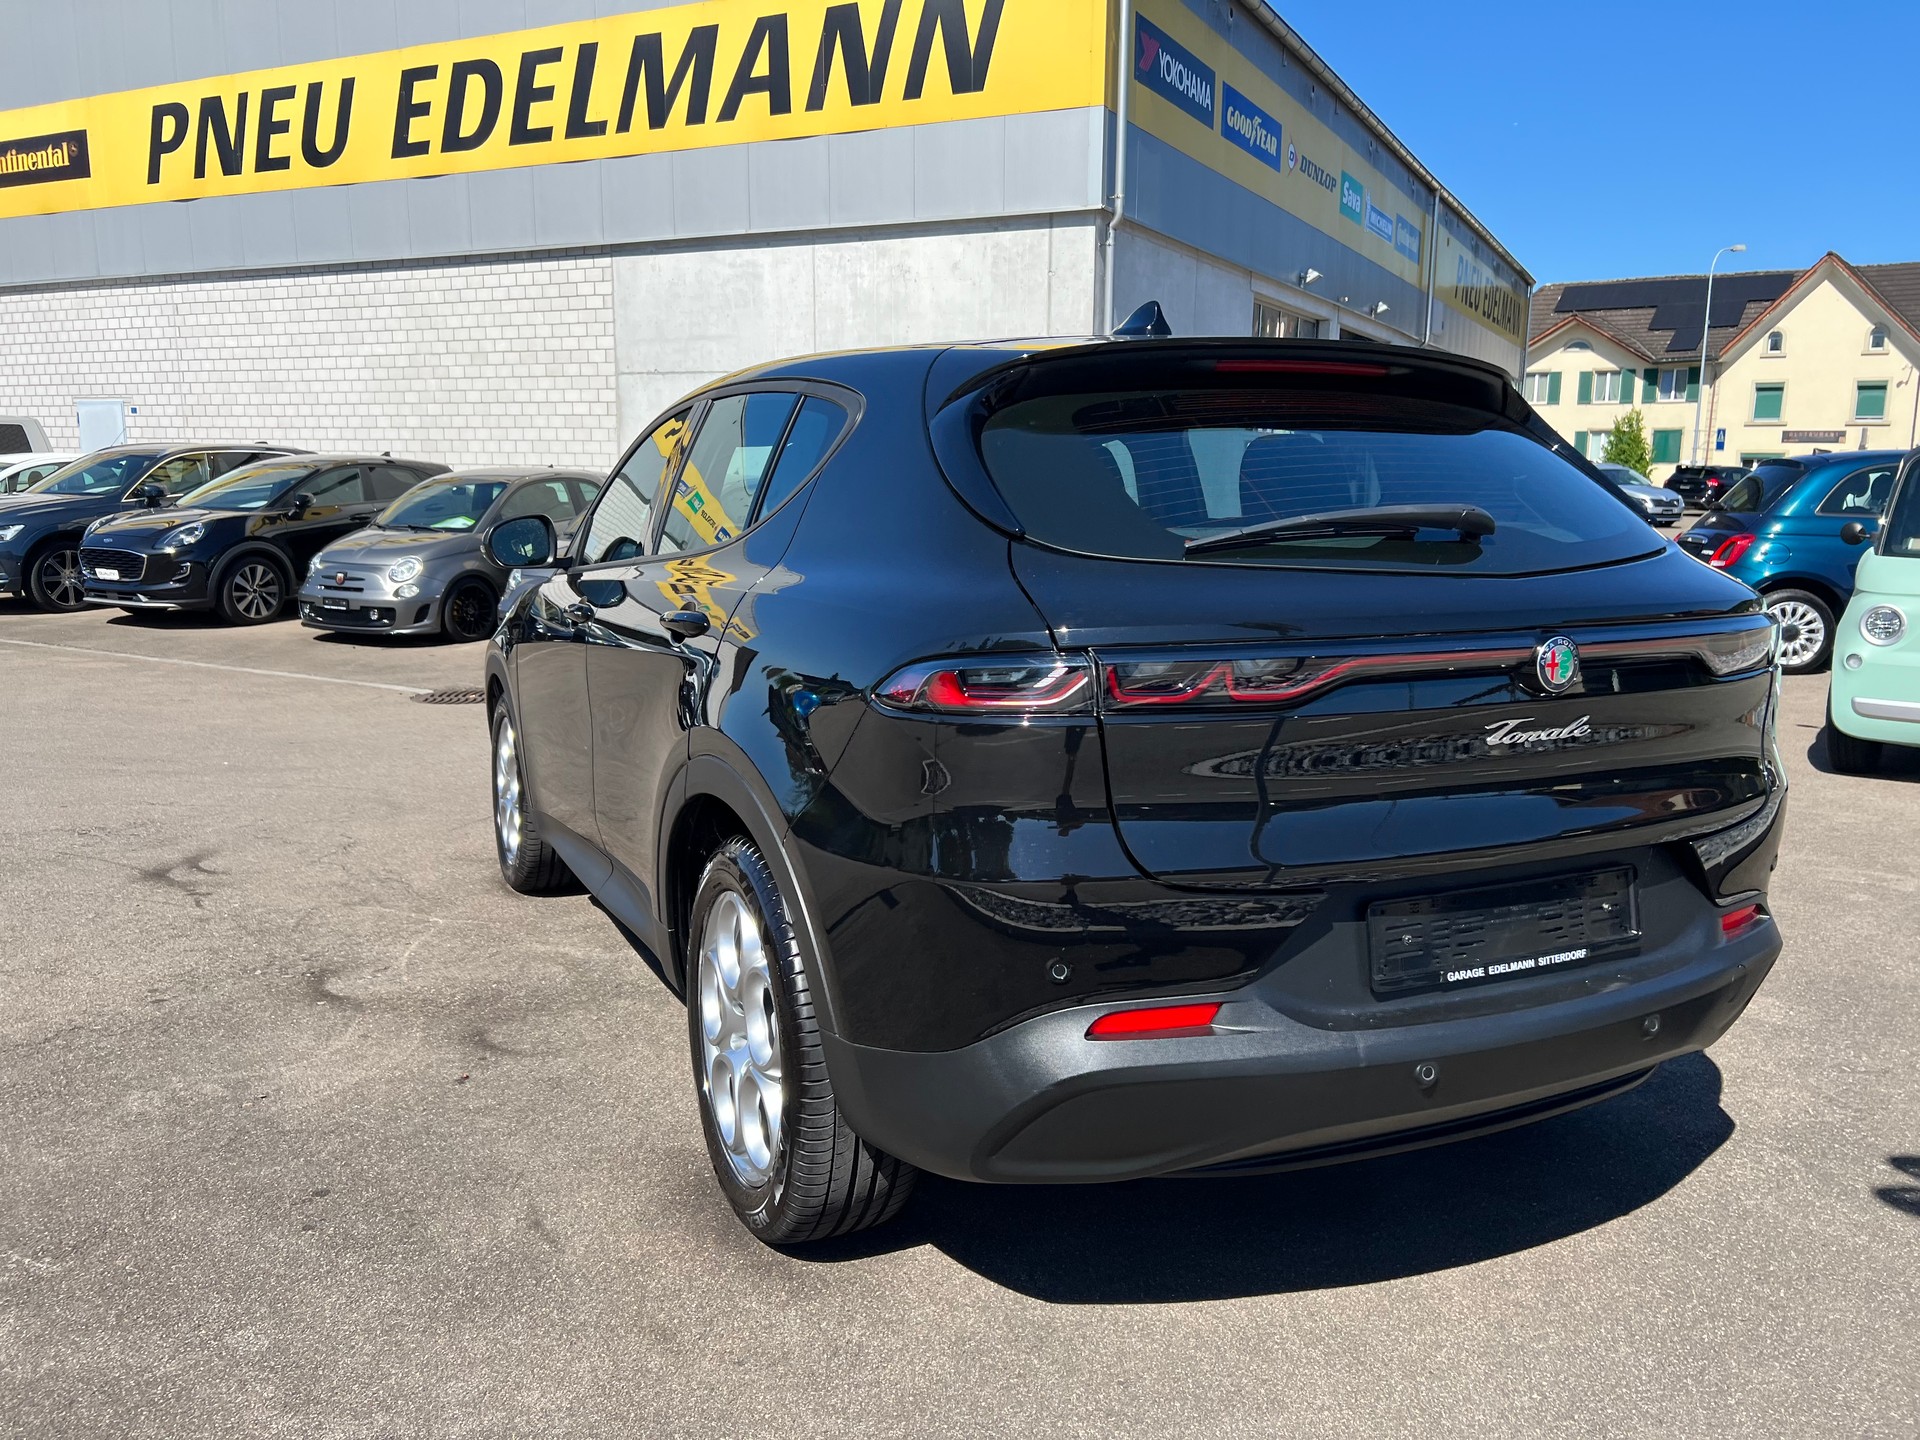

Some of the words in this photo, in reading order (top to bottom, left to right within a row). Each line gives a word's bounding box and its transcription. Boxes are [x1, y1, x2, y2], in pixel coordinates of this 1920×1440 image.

[147, 76, 356, 185] PNEU
[391, 0, 1004, 160] EDELMANN
[1158, 47, 1212, 111] YOKOHAMA
[1299, 154, 1337, 193] DUNLOP
[1342, 180, 1361, 213] Sava
[1454, 254, 1483, 313] PNEU
[1482, 276, 1521, 339] EDELMANN
[1540, 642, 1555, 666] ALFA
[1484, 715, 1592, 746] Tonale
[1446, 967, 1485, 982] GARAGE
[1488, 958, 1535, 975] EDELMANN
[1537, 948, 1587, 966] SITTERDORF
